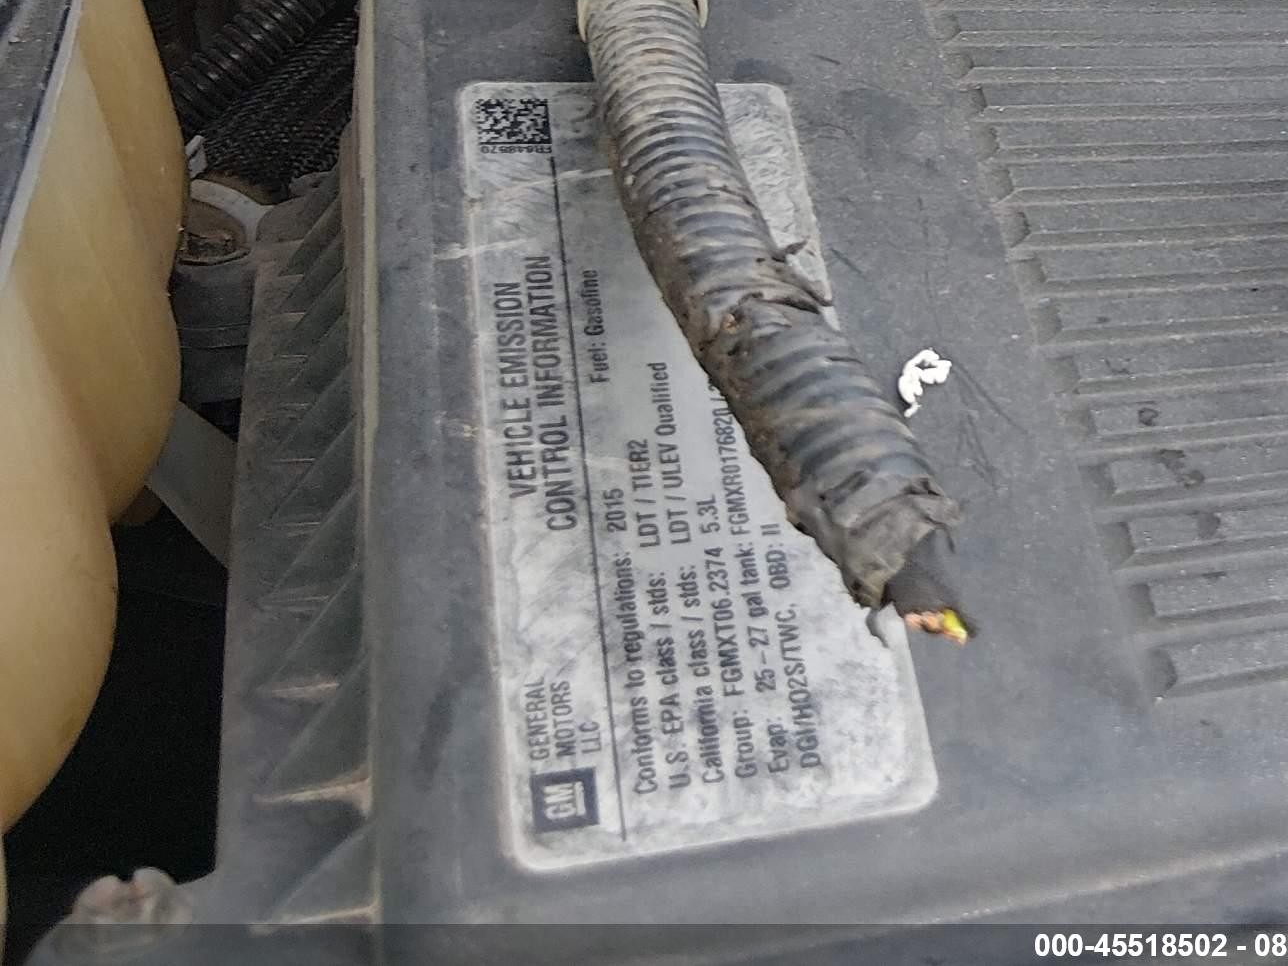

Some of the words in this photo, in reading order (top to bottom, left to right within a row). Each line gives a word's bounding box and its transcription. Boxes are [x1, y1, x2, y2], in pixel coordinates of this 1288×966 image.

[580, 269, 605, 336] Gasoline
[494, 282, 530, 388] EMISSION
[524, 255, 565, 407] INFORMATION
[588, 342, 610, 383] Fuel:
[646, 362, 678, 436] Qualified
[500, 397, 538, 498] VEHICLE
[626, 438, 654, 492] TIER2
[657, 442, 684, 488] ULEV
[710, 408, 751, 536] FGMXR0176820
[537, 414, 578, 531] CONTROL
[602, 488, 628, 533] 2015
[636, 511, 660, 548] LDT
[666, 508, 692, 545] LDT
[696, 494, 721, 534] 5.3L
[676, 564, 701, 608] stds:
[734, 542, 762, 586] tank:
[765, 543, 792, 590] OBD:
[613, 552, 644, 662] regulations:
[646, 572, 670, 616] stds:
[740, 591, 770, 618] gal
[703, 546, 745, 698] FGMXT06.2374
[654, 637, 678, 686] class
[686, 628, 712, 678] class
[623, 669, 646, 688] to
[524, 676, 550, 761] GENERAL
[550, 680, 576, 756] MOTORS
[578, 721, 602, 754] LLC
[658, 693, 684, 735] EPA
[694, 686, 726, 784] California
[632, 696, 658, 794] Conforms
[664, 744, 692, 790] U.S.
[730, 709, 758, 779] Group:
[765, 716, 792, 773] Evap:
[543, 781, 576, 821] GM
